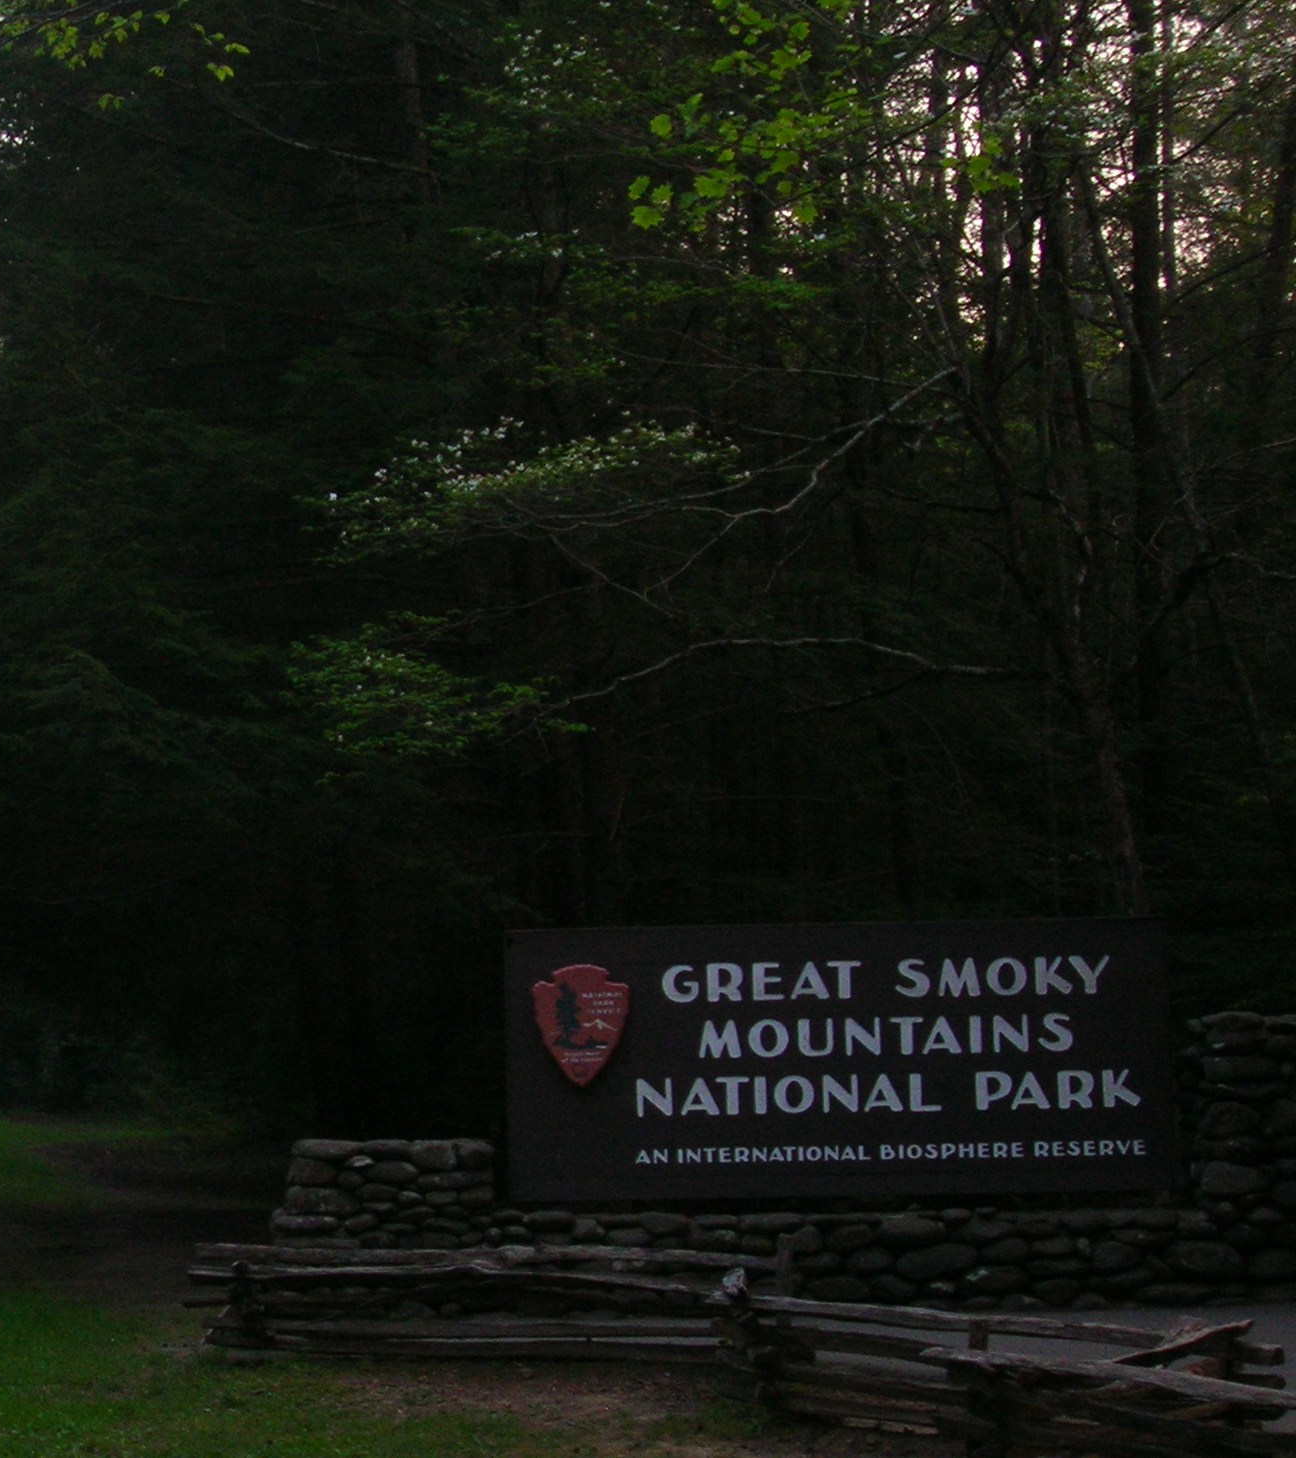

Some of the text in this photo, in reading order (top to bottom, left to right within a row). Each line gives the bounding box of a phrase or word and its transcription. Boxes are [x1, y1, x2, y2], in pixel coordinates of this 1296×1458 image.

[661, 956, 1110, 1003] GREAT SMOKY
[698, 1013, 1074, 1059] MOUNTAINS
[636, 1069, 1143, 1118] NATIONAL PARK
[635, 1140, 1146, 1165] AN INTERNATIONAL BIOSPHERE RESERVE
